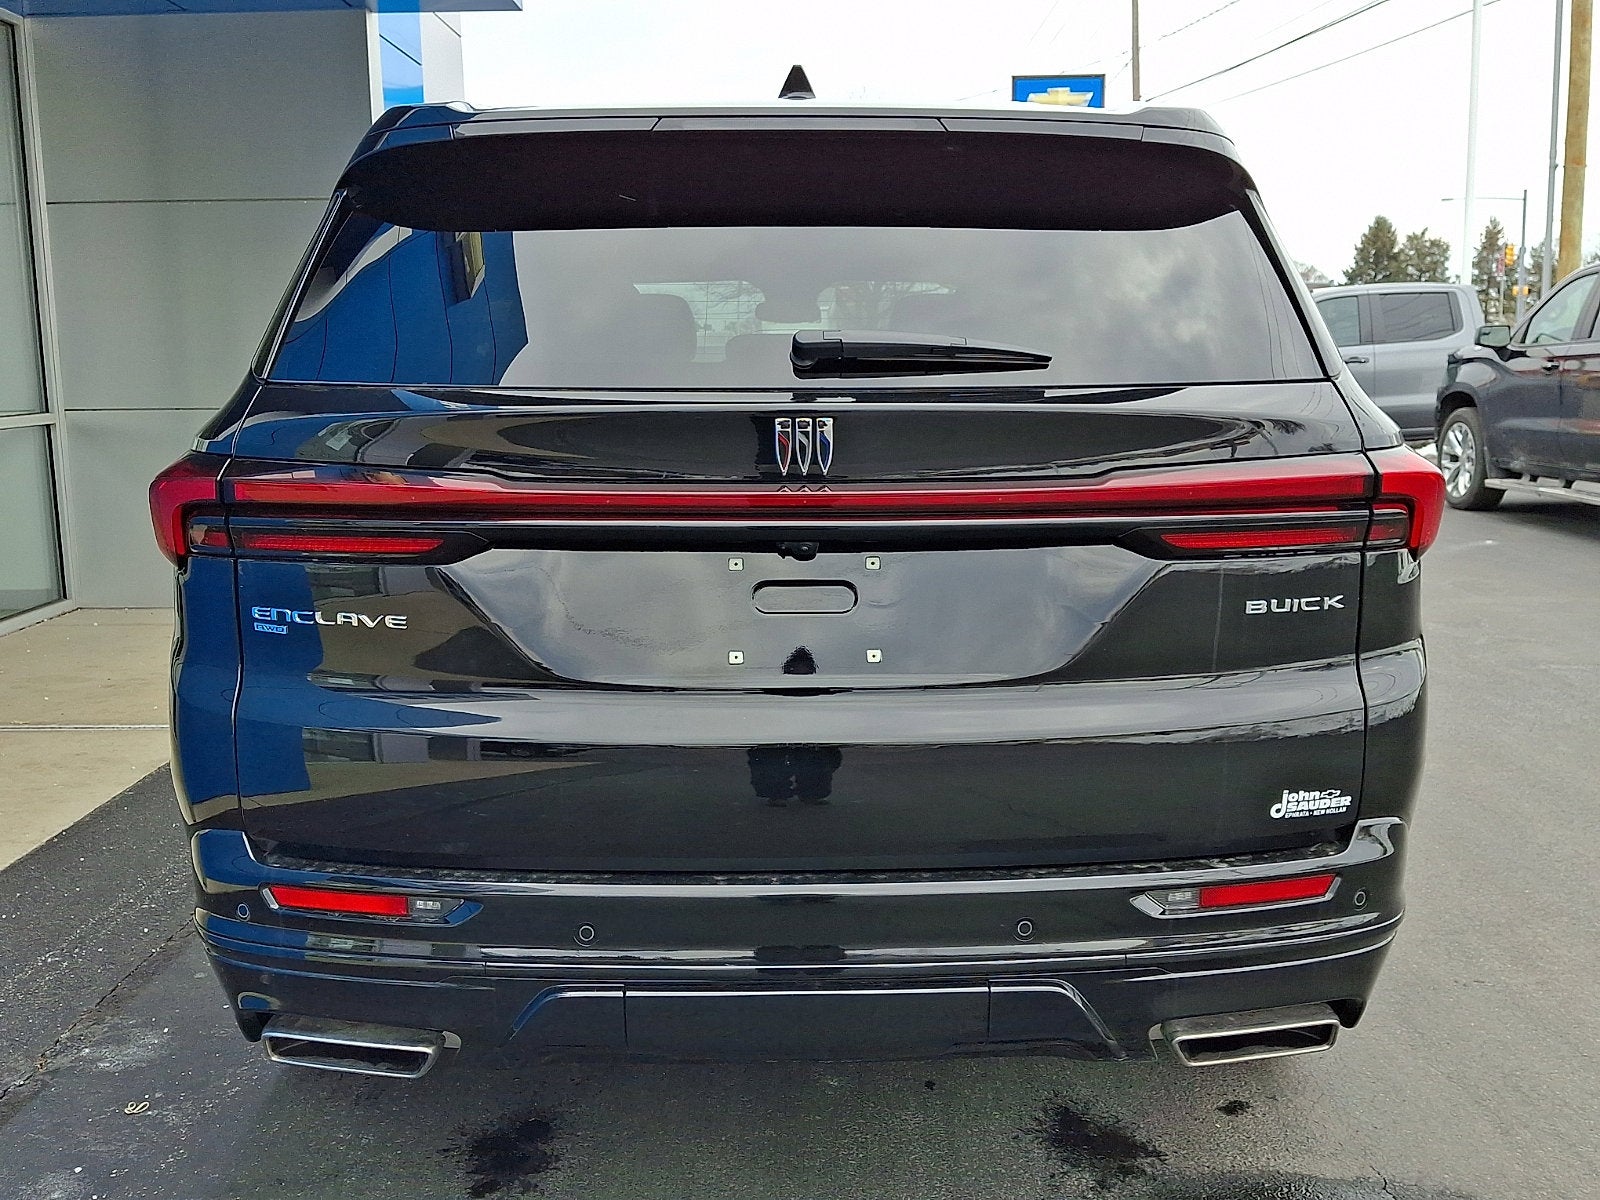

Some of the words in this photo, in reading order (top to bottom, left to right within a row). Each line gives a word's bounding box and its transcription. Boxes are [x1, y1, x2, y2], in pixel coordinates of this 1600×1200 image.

[1245, 595, 1345, 614] BUICK
[252, 606, 408, 629] ENCLAVE
[254, 622, 288, 634] AWD
[1286, 796, 1352, 812] SAUDER
